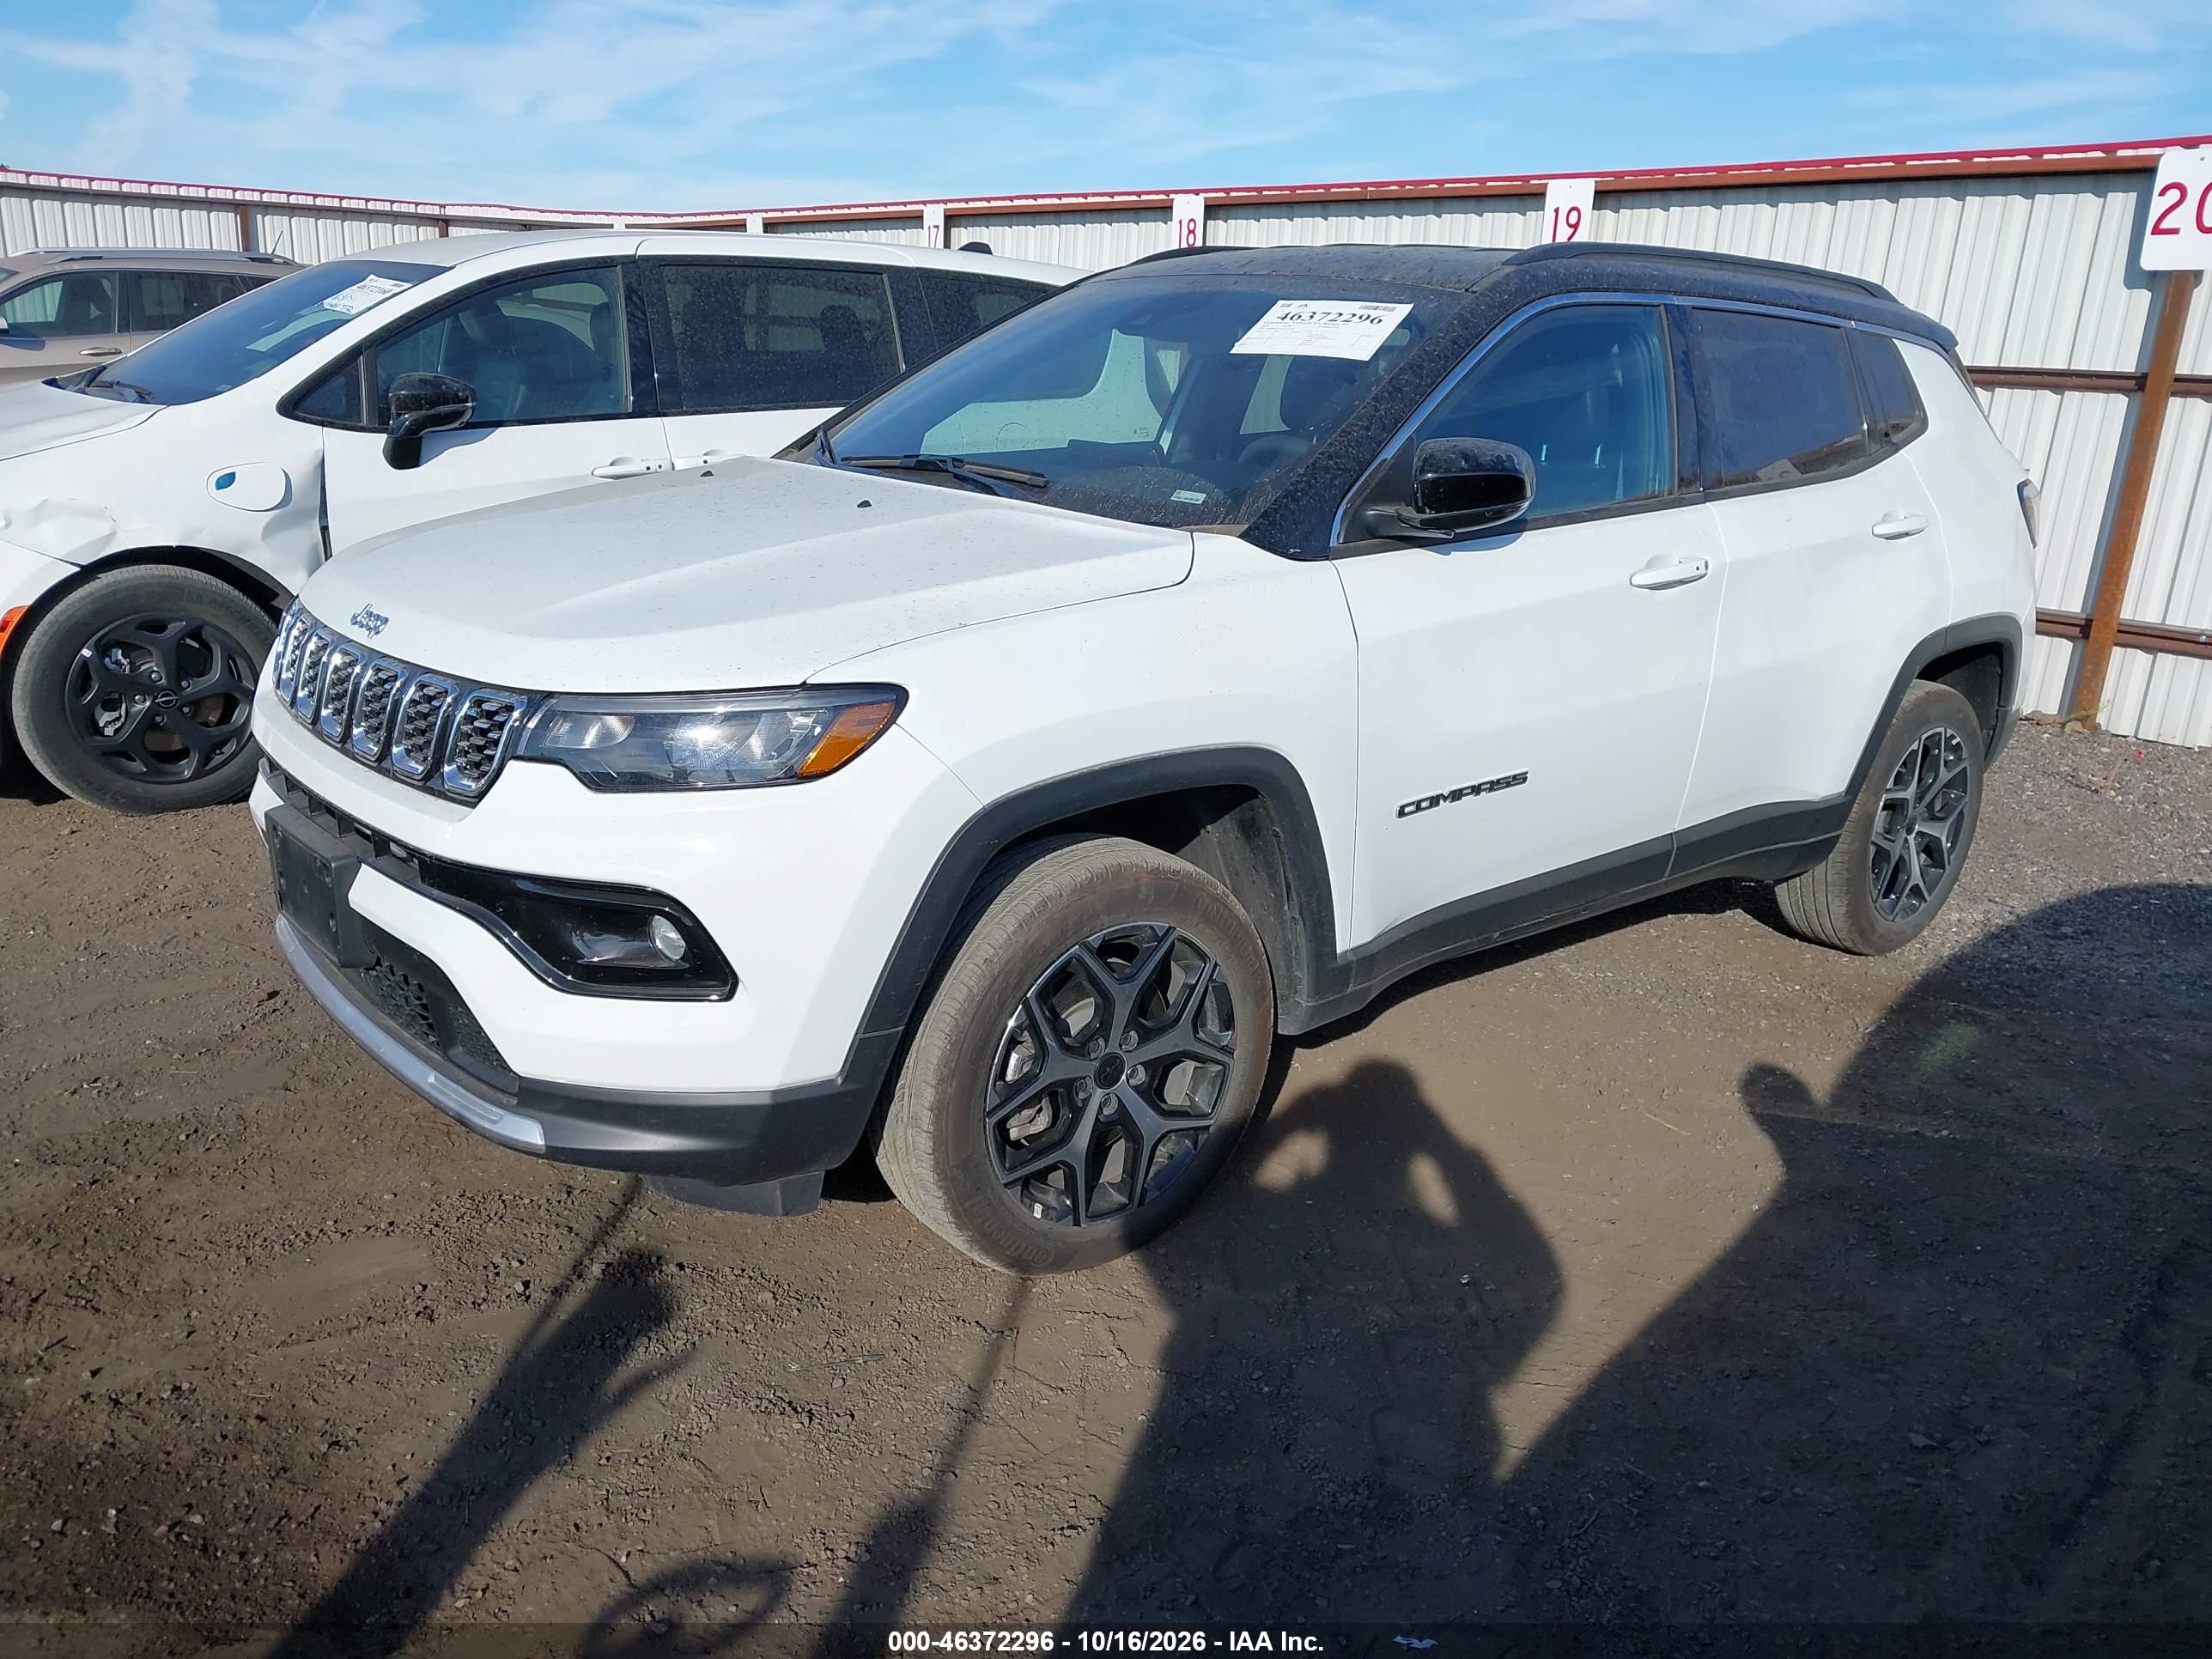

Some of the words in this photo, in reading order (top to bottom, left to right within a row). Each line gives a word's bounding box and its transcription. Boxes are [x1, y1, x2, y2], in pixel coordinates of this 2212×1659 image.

[928, 225, 940, 247] 17
[1178, 218, 1197, 248] 18
[1552, 206, 1582, 243] 19
[1276, 311, 1386, 325] 46372296
[350, 604, 389, 639] Jeep
[1396, 771, 1528, 818] COMPASS
